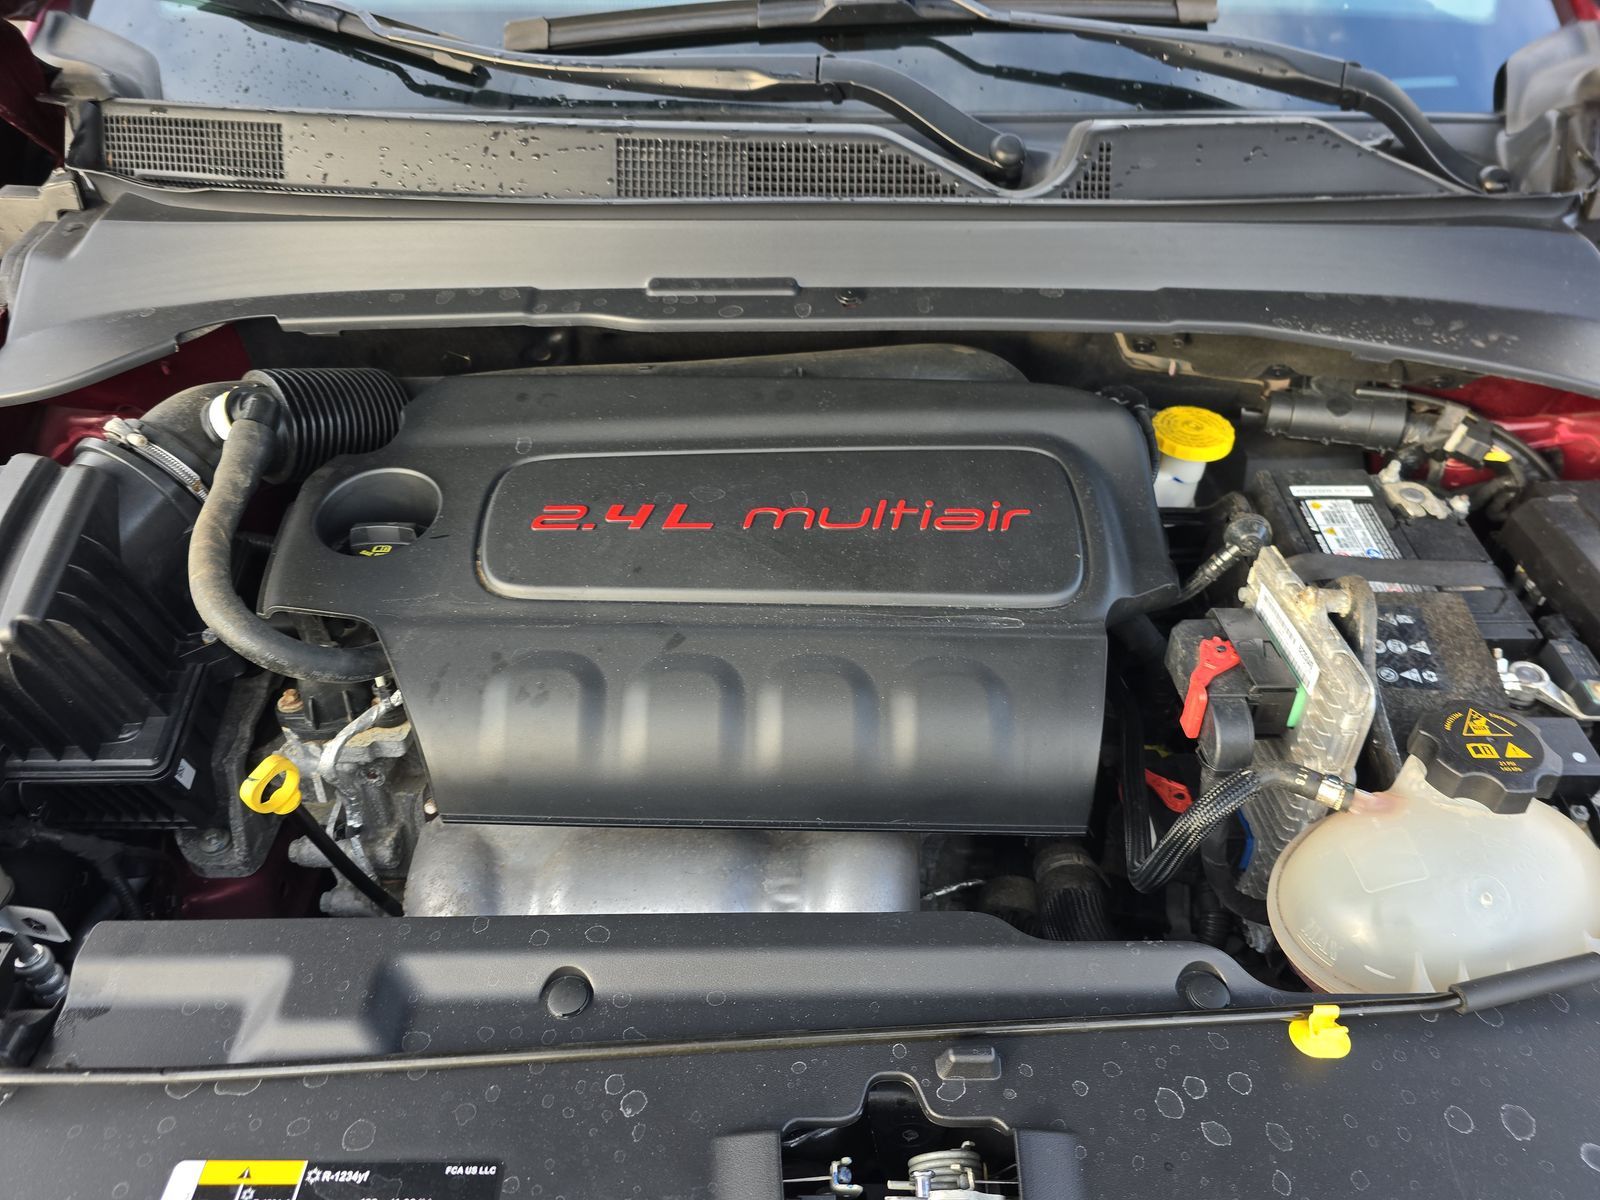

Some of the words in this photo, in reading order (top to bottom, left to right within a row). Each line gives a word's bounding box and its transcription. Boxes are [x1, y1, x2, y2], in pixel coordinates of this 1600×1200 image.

[742, 499, 1032, 532] multiair
[444, 1165, 464, 1176] FCA
[464, 1165, 478, 1176] US
[478, 1165, 497, 1176] LLC
